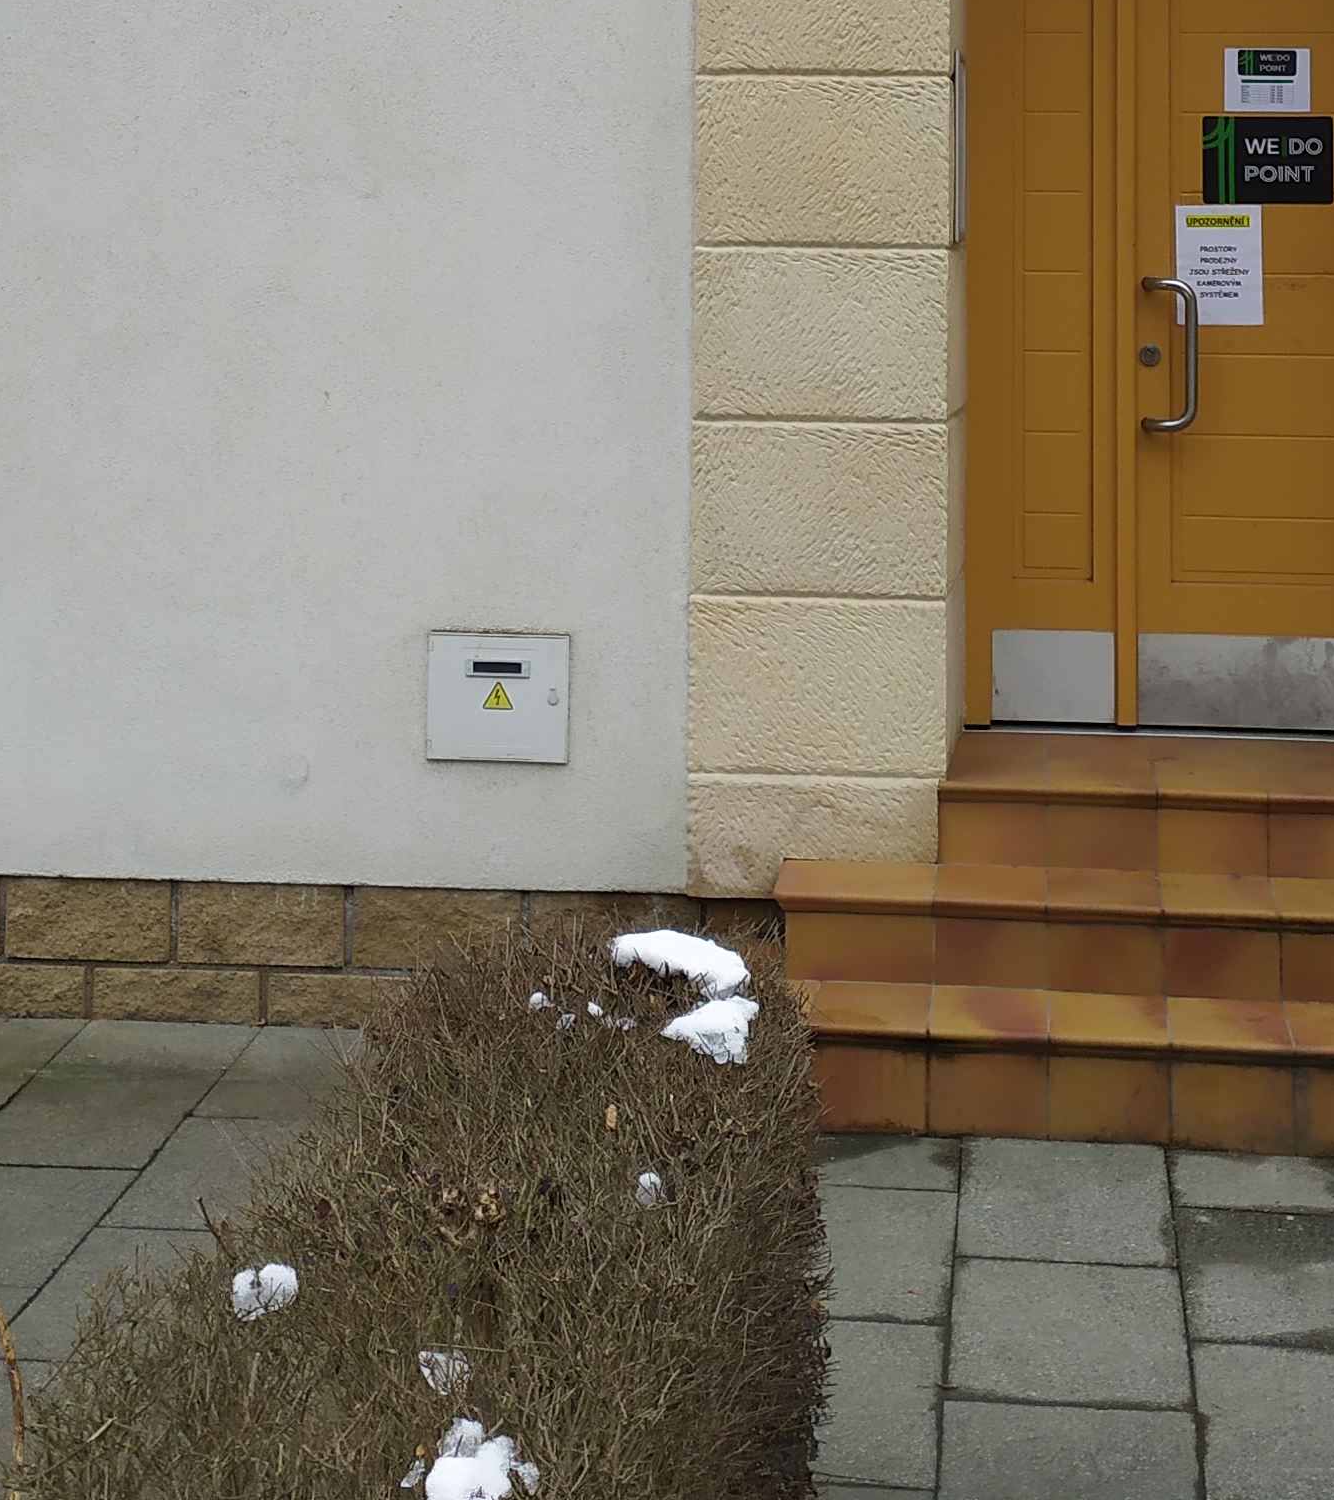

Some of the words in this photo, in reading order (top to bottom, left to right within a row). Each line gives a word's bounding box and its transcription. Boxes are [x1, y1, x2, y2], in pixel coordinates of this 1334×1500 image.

[1259, 54, 1273, 62] WE
[1276, 54, 1290, 62] DO
[1259, 64, 1287, 72] POINT
[1244, 137, 1280, 155] WE
[1288, 137, 1323, 156] DO
[1244, 165, 1315, 183] POINT
[1188, 268, 1209, 276] JSOU
